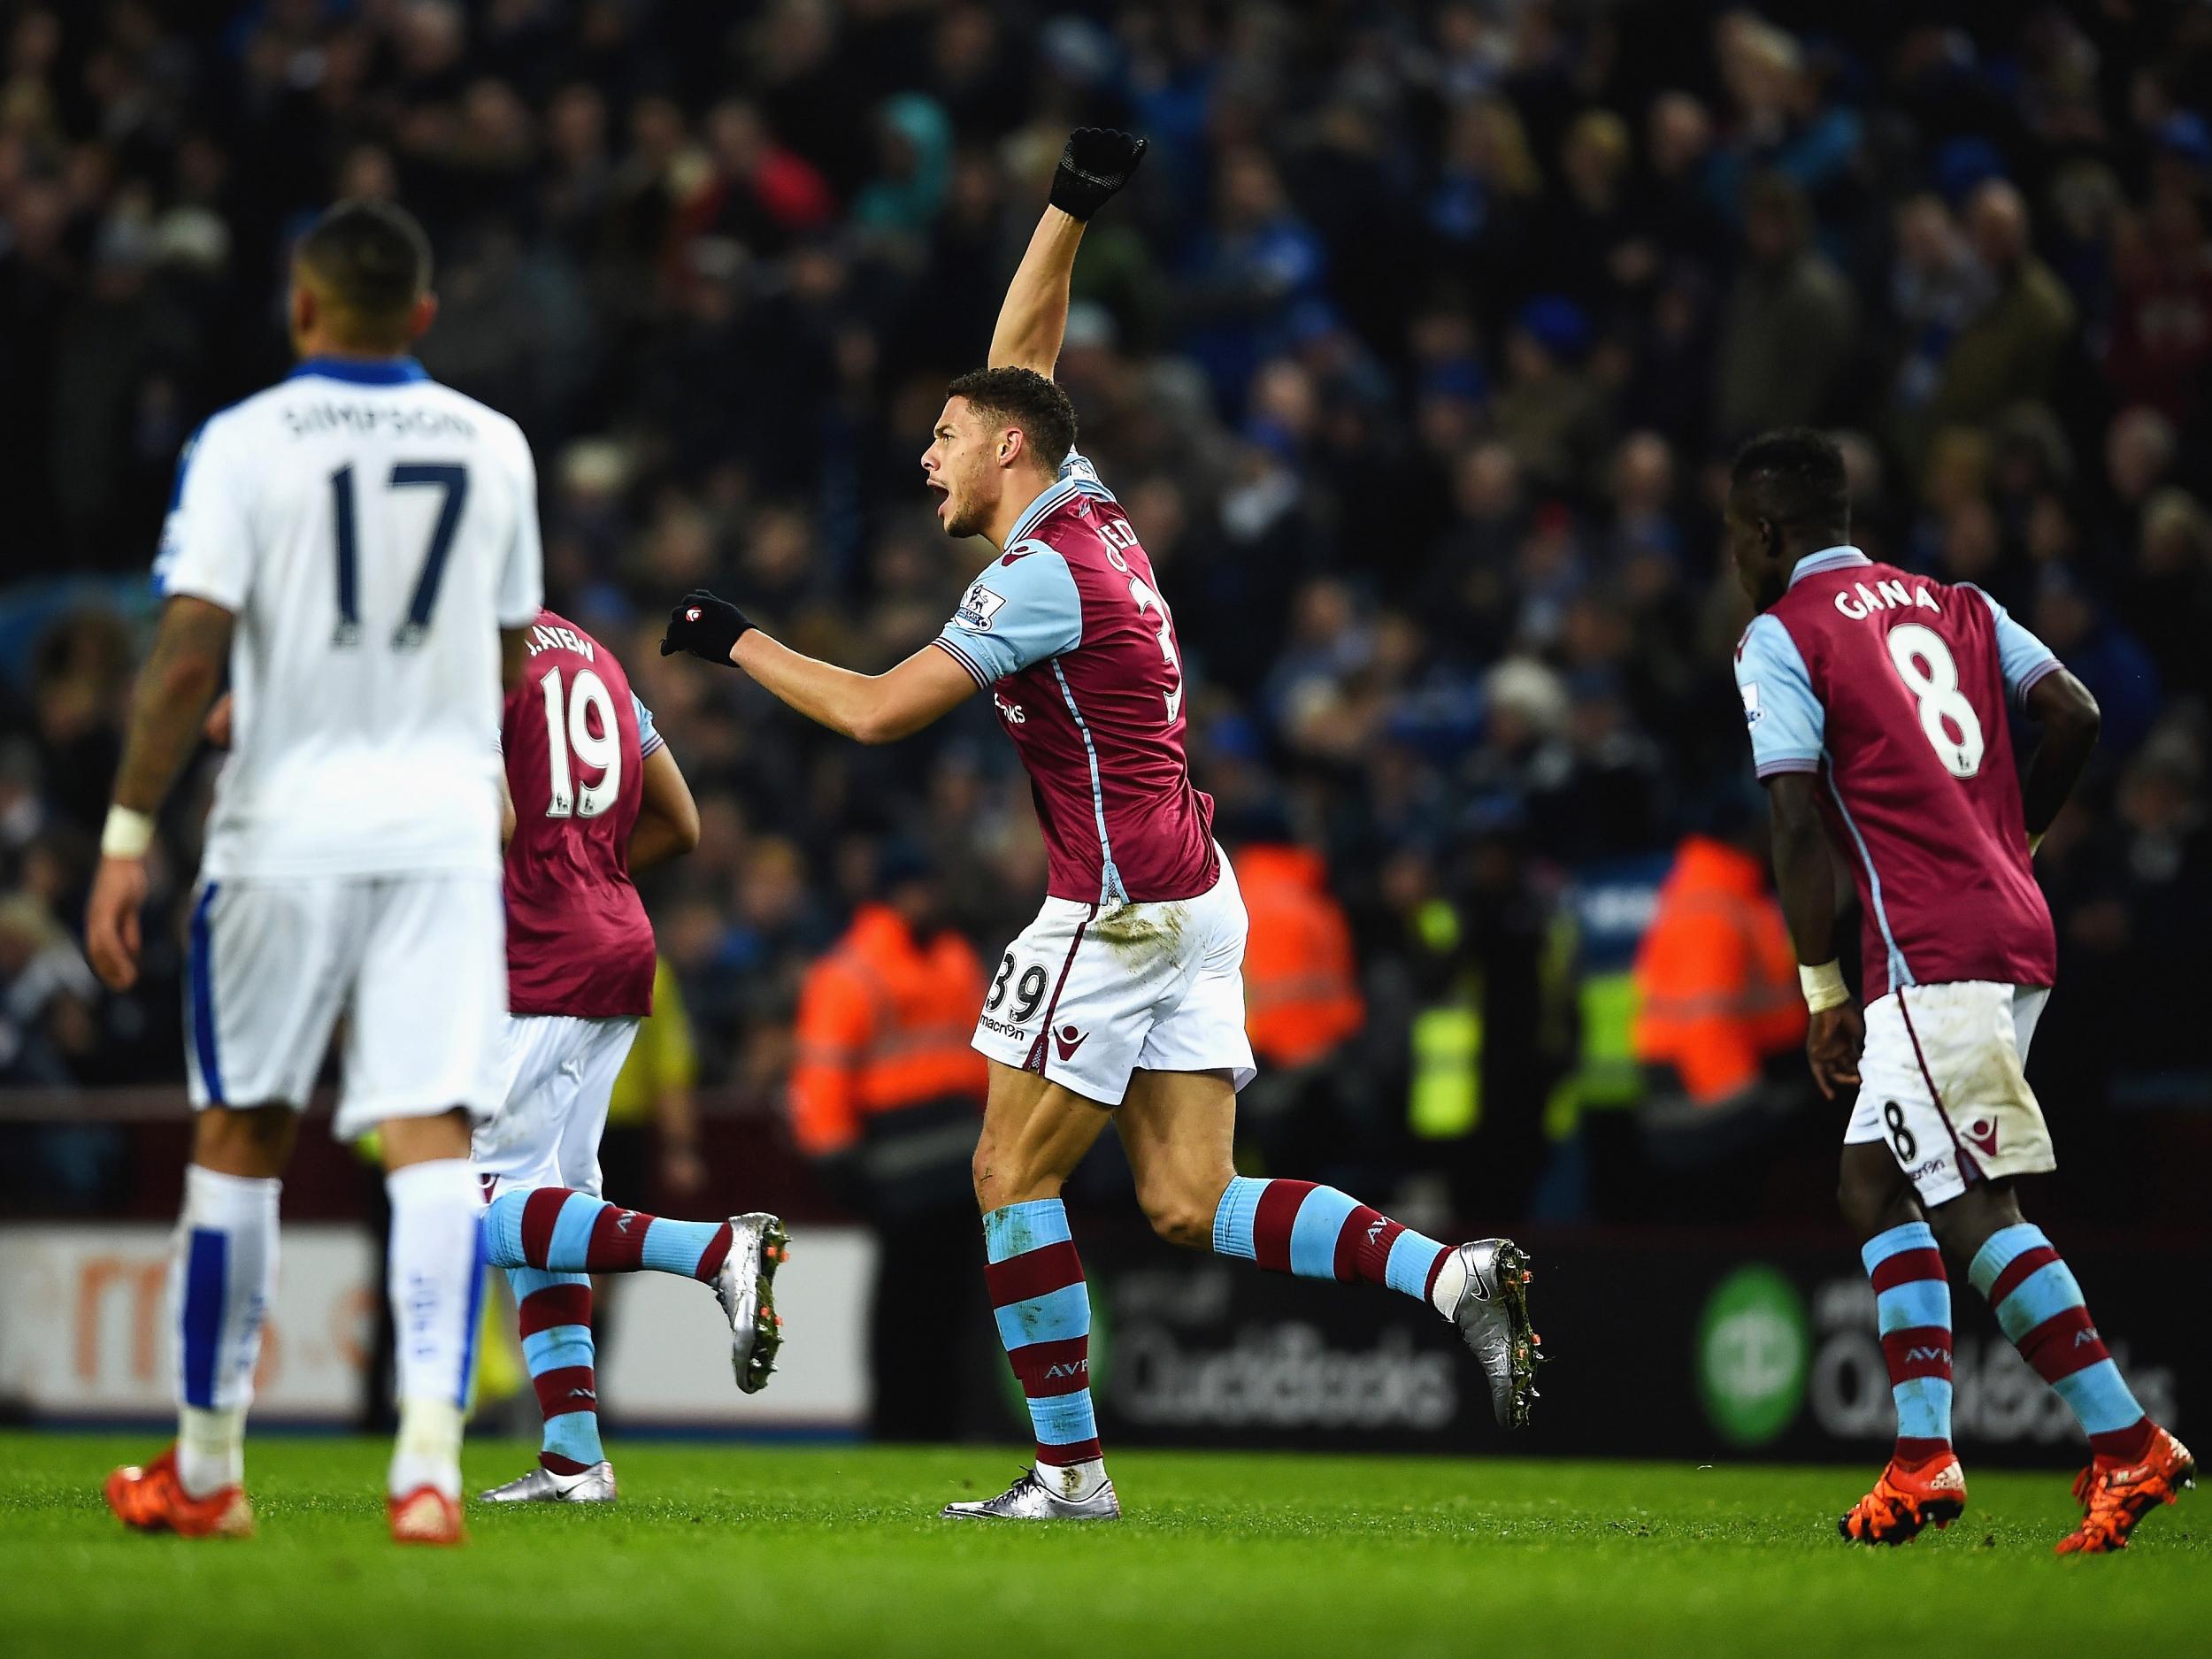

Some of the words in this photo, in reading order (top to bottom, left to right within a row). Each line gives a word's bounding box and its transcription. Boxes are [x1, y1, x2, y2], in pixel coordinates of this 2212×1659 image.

[330, 462, 469, 651] 17
[1834, 580, 1940, 619] GANA
[1887, 623, 1985, 780] 8
[540, 666, 622, 818] 19
[985, 951, 1048, 1024] 39
[979, 1014, 1025, 1041] macron
[1884, 1100, 1917, 1164] 8
